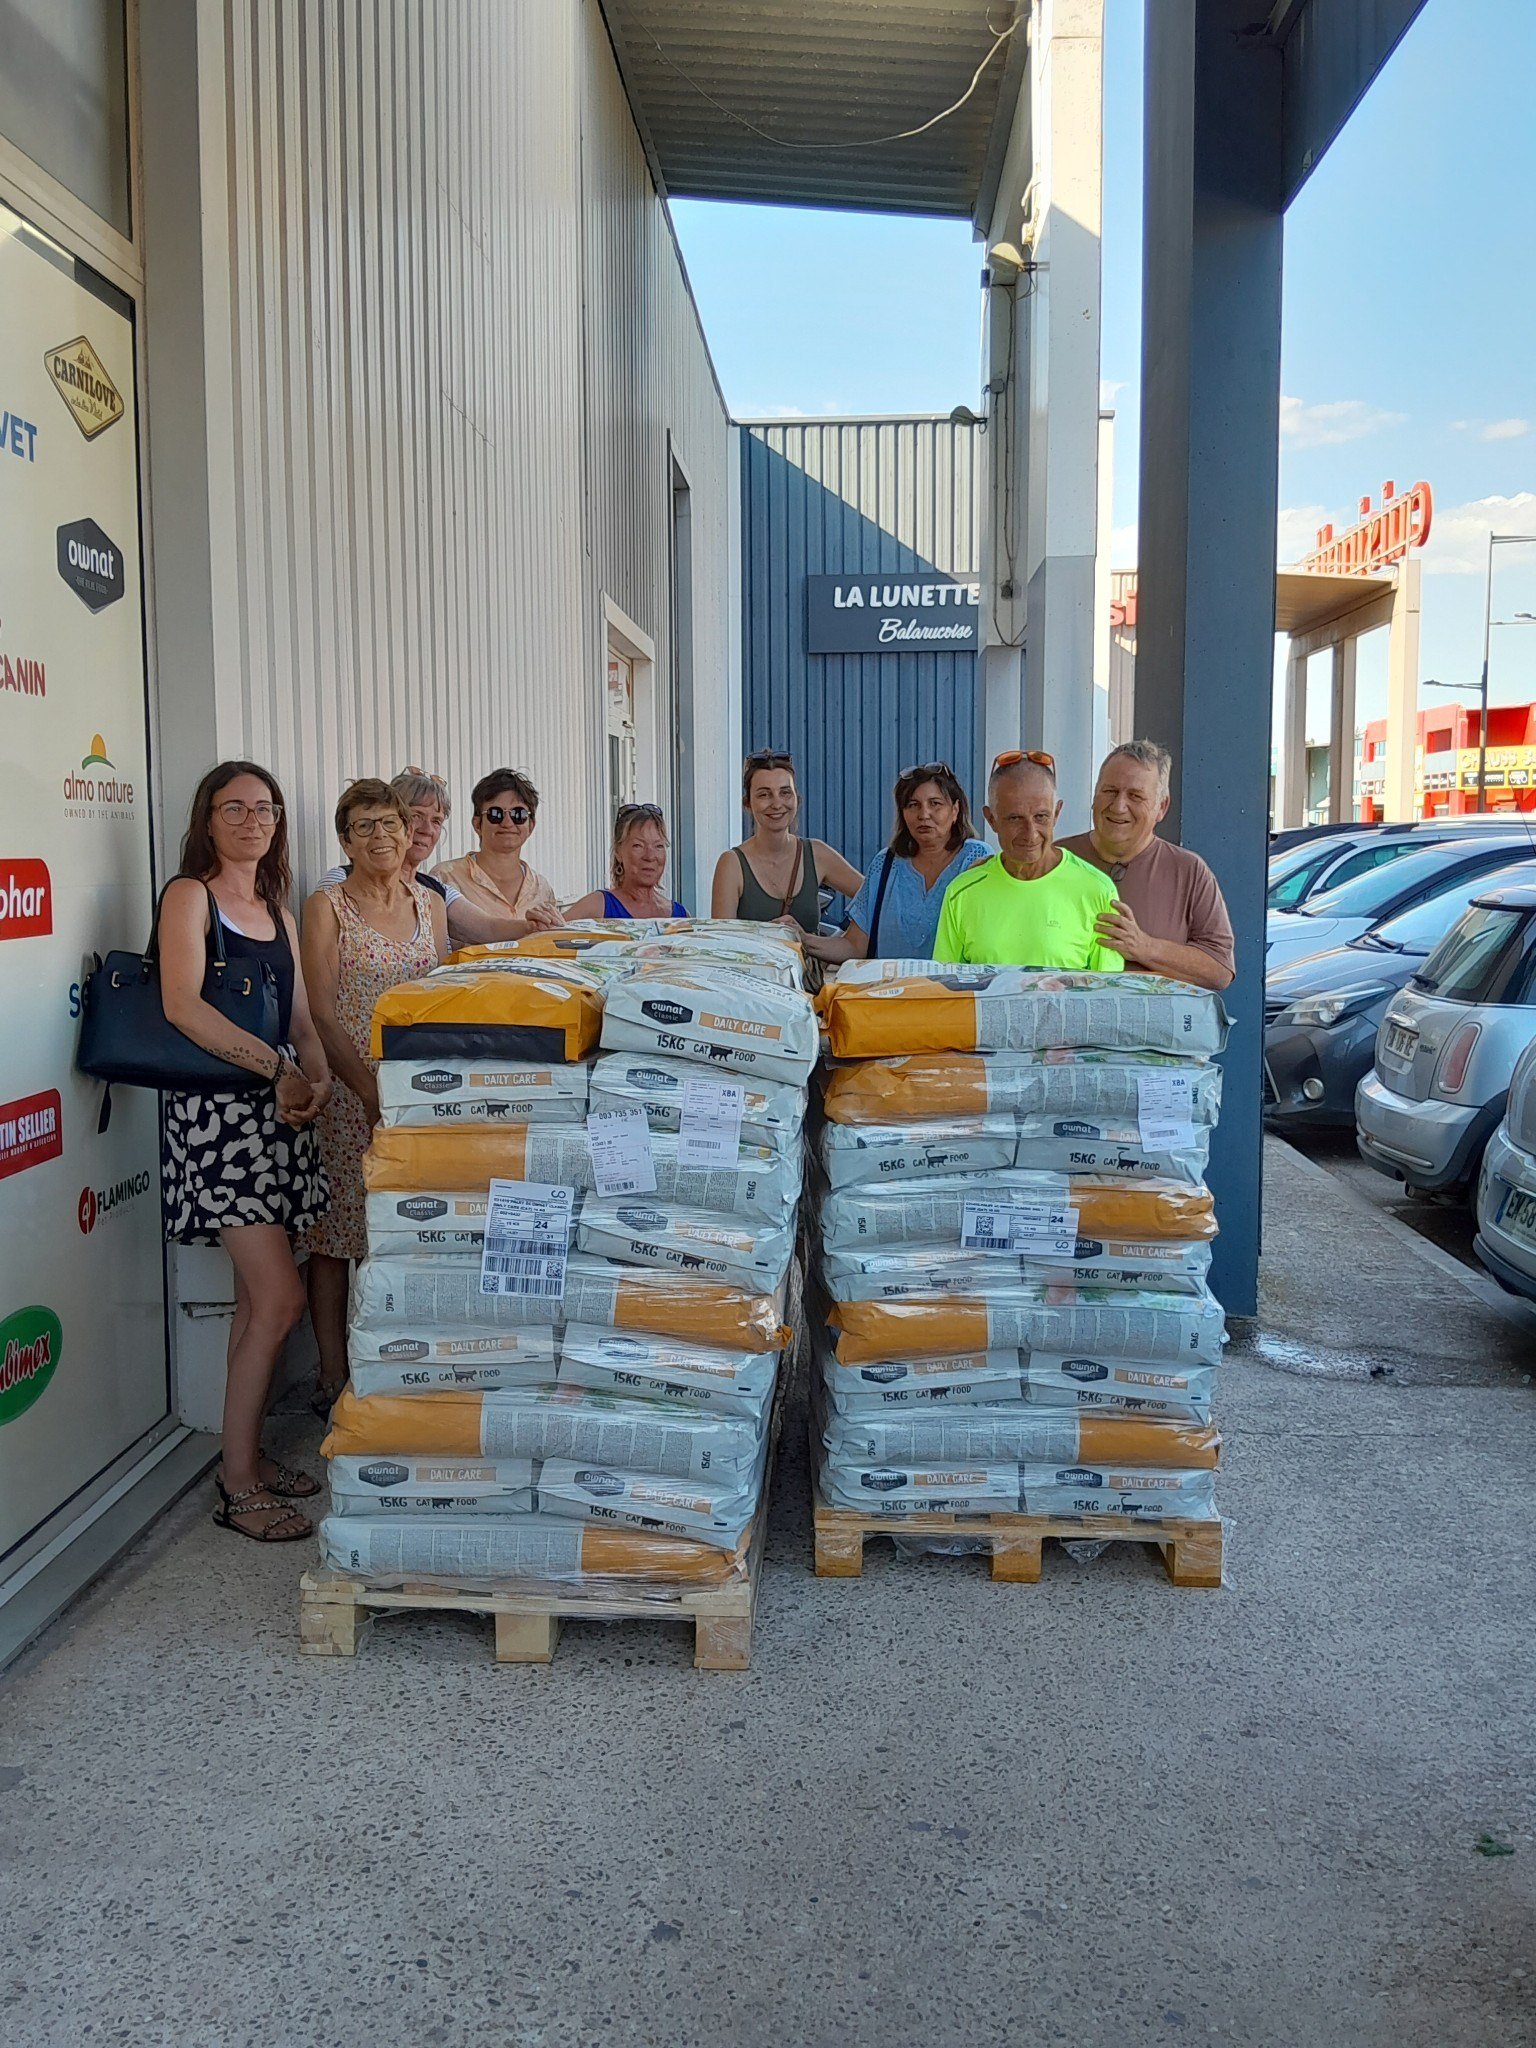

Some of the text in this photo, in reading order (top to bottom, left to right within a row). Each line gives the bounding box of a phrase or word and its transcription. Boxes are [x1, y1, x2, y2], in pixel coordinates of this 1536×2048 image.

[54, 356, 116, 413] CARNILOVE
[68, 540, 115, 580] ownat
[834, 583, 980, 608] LA LUNETTE
[878, 618, 973, 643] Balarucoise
[64, 770, 134, 804] almo nature
[651, 1002, 684, 1015] ownat
[714, 1017, 766, 1035] DAILY CARE
[1183, 1014, 1192, 1033] 15KG
[657, 1035, 756, 1062] 15KG CAT FOOD
[421, 1074, 453, 1083] ownat
[484, 1074, 537, 1085] DAILY CARE
[637, 1070, 669, 1083] ownat
[722, 1089, 737, 1098] XBA
[432, 1103, 533, 1116] 15KG CAT FOOD
[18, 1107, 56, 1144] SELLIER
[1062, 1124, 1092, 1134] ownat
[878, 1153, 969, 1171] 15KG CAT FOOD
[1069, 1153, 1160, 1171] 15KG CAT FOOD
[97, 1170, 150, 1215] FLAMINGO
[747, 1181, 757, 1200] 15KG
[406, 1200, 438, 1209] ownat
[469, 1203, 487, 1214] DAIL
[535, 1220, 548, 1229] 24
[858, 1217, 867, 1234] 15KG
[1051, 1215, 1064, 1223] 24
[417, 1230, 470, 1243] 15KG CAT
[630, 1241, 727, 1272] 15KG CAT FOOD
[1122, 1246, 1170, 1258] DAILY CARE
[1073, 1268, 1163, 1281] 15KG CAT FOOD
[385, 1293, 394, 1312] 15KG
[388, 1343, 419, 1352] ownat
[451, 1340, 502, 1353] DAILY CARE
[1190, 1332, 1199, 1349] 15KG
[952, 1359, 973, 1369] CARE
[1070, 1362, 1099, 1372] ownat
[401, 1369, 500, 1384] 15KG CAT FOOD
[1127, 1372, 1175, 1386] DAILY CARE
[613, 1372, 711, 1399] 15KG CAT FOOD
[881, 1385, 972, 1402] 15KG CAT FOOD
[1076, 1390, 1167, 1410] 15KG CAT FOOD
[867, 1440, 876, 1456] 15KG
[701, 1450, 711, 1469] 15KG
[368, 1466, 399, 1475] ownat
[430, 1468, 482, 1479] DAILY CARE
[1065, 1472, 1093, 1480] ownat
[584, 1473, 617, 1487] ownat
[926, 1474, 974, 1483] DAILY CARE
[1122, 1477, 1145, 1487] DAILY
[380, 1497, 477, 1507] 15KG CAT FOOD
[881, 1500, 970, 1511] 15KG CAT FOOD
[1073, 1500, 1099, 1511] 15KG
[1107, 1504, 1120, 1512] CAT
[589, 1505, 687, 1533] 15KG CAT FOOD
[351, 1549, 360, 1568] 15KG
